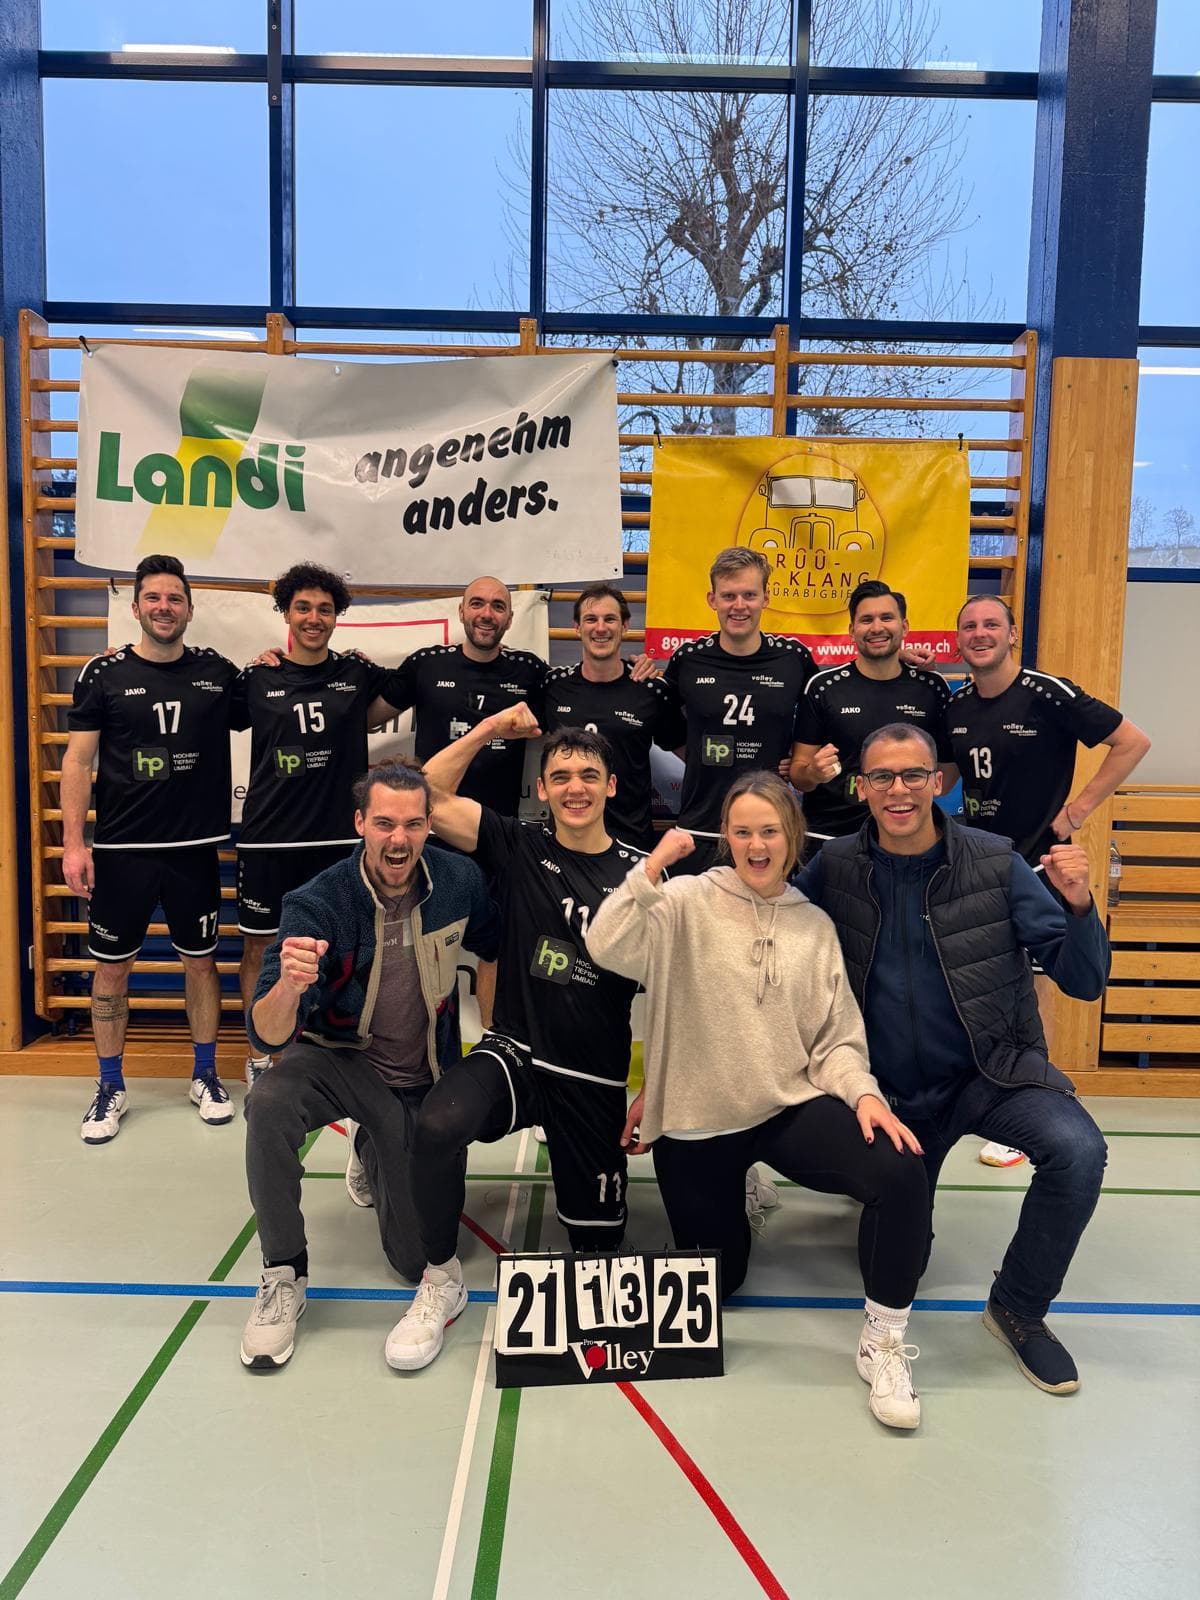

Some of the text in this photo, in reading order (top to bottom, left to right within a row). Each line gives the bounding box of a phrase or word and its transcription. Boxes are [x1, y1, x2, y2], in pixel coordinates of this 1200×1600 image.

[354, 412, 571, 489] angenehm
[96, 431, 306, 512] Landi
[403, 477, 559, 535] anders.
[124, 687, 146, 696] JAKO
[266, 690, 285, 698] JAKO
[477, 695, 485, 710] 7
[152, 701, 181, 734] 17
[293, 701, 325, 734] 15
[723, 694, 755, 726] 24
[137, 751, 164, 777] hp
[277, 749, 301, 774] hp
[706, 738, 729, 763] hp
[969, 746, 993, 779] 13
[540, 859, 561, 874] JAKO
[199, 911, 218, 938] 17
[561, 897, 590, 939] 11
[538, 940, 569, 976] hp
[597, 1171, 622, 1203] 11
[507, 1271, 712, 1347] 21 1 3 25
